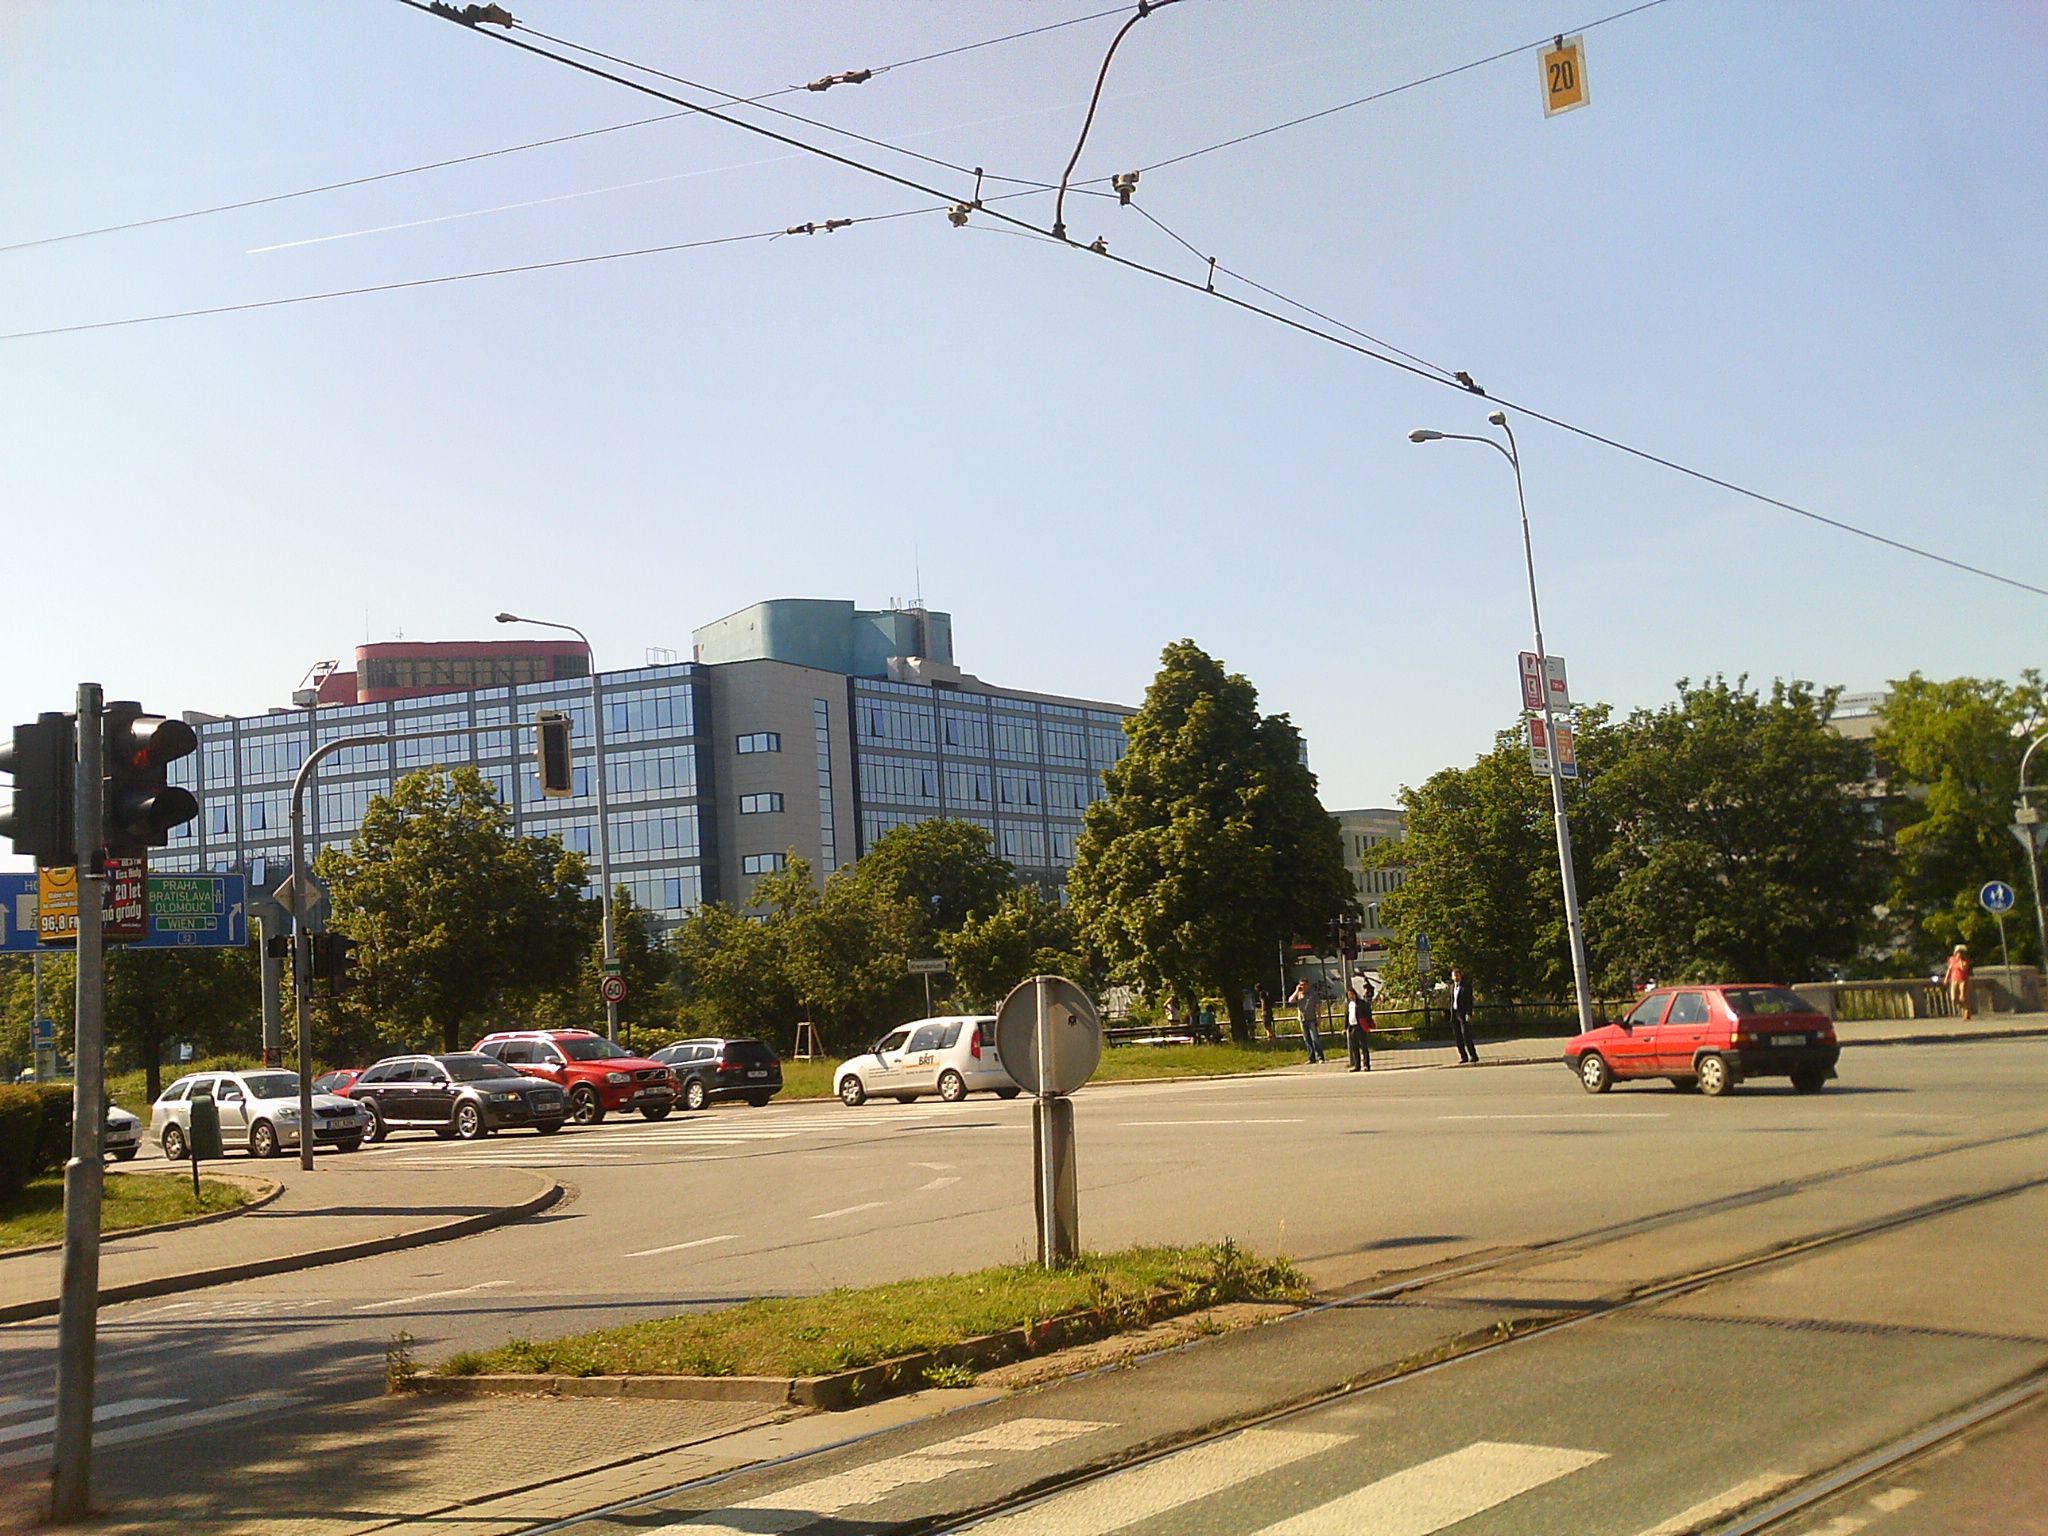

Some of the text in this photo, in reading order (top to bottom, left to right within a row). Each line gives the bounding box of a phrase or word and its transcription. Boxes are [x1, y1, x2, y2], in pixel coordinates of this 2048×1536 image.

[1550, 61, 1574, 93] 20
[162, 880, 198, 891] PRAHA
[115, 883, 142, 901] 20 let
[148, 891, 211, 902] BRATISLAVA
[115, 900, 142, 923] grády
[155, 902, 206, 913] OLOMOUC
[41, 914, 65, 933] 96,8
[167, 918, 196, 930] WIEN
[608, 984, 620, 995] 60
